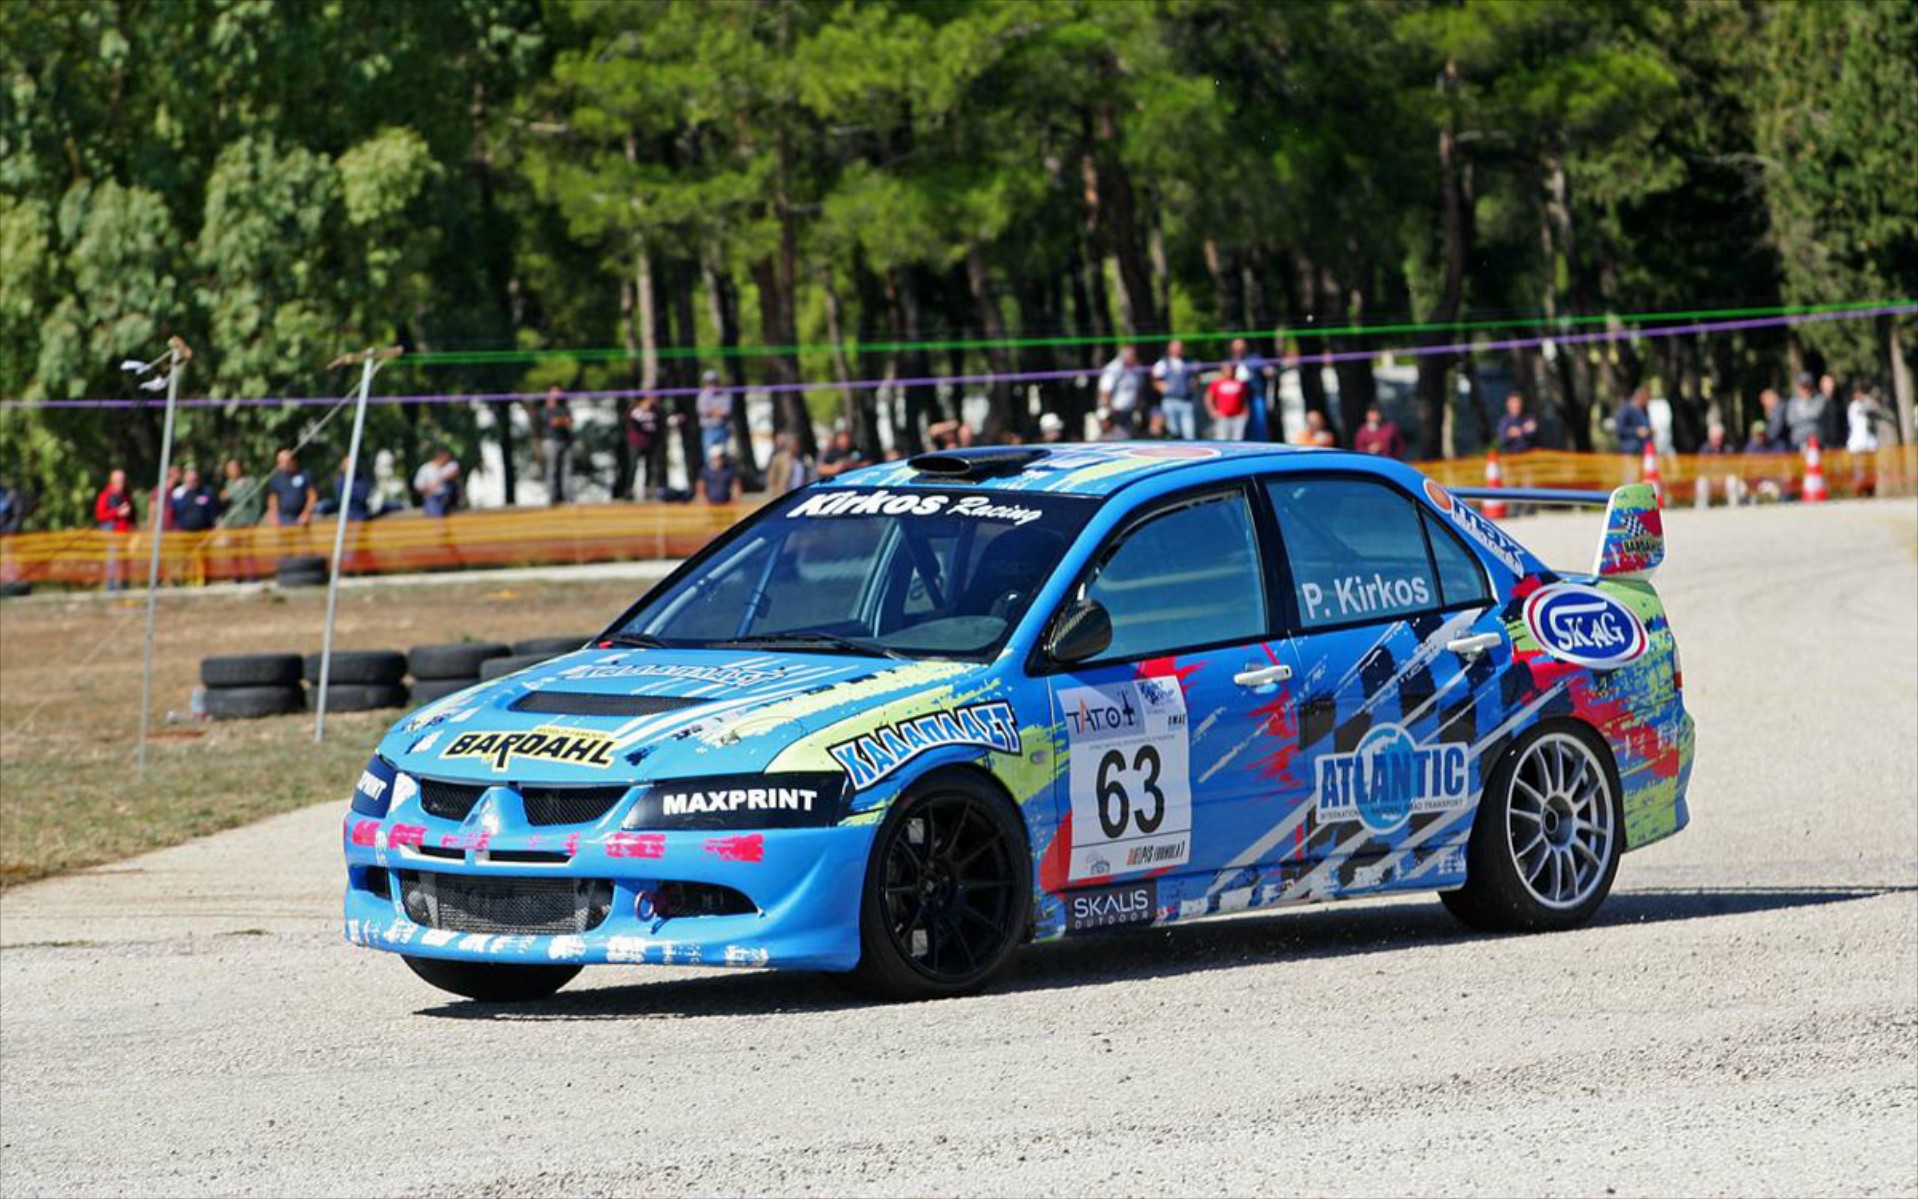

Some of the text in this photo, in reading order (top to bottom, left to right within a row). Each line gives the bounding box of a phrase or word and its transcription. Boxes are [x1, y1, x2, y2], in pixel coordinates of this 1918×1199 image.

[786, 490, 1042, 526] Kirkos Racing
[1302, 573, 1430, 619] P. Kirkos
[1550, 601, 1626, 651] SKAG
[445, 733, 616, 769] BARDAHL
[1096, 745, 1165, 839] 63
[1321, 747, 1465, 808] ATLANTIC
[662, 788, 818, 816] MAXPRINT
[1074, 890, 1149, 919] SKALIS
[1074, 910, 1149, 930] OUTDOOR
